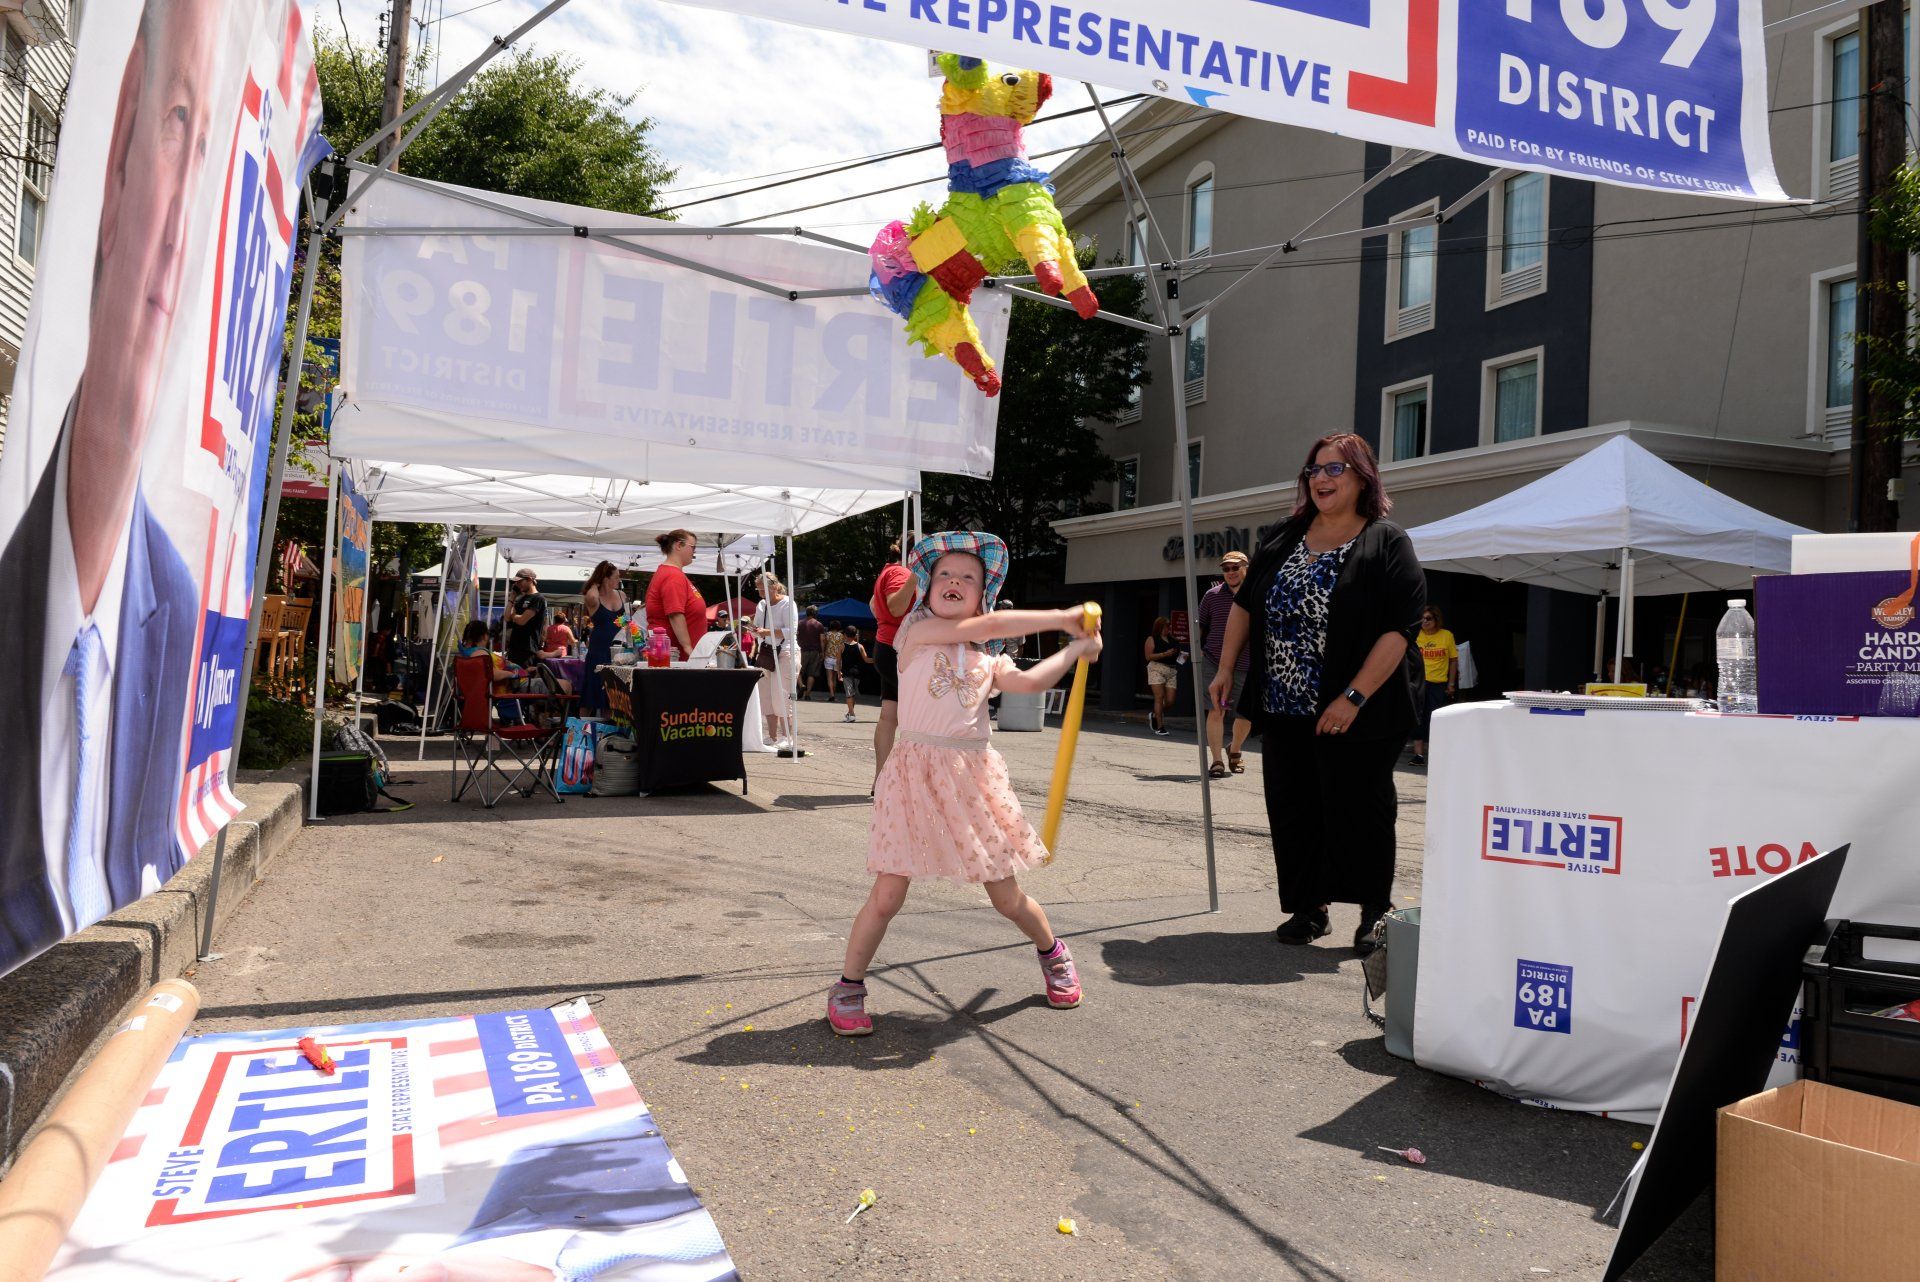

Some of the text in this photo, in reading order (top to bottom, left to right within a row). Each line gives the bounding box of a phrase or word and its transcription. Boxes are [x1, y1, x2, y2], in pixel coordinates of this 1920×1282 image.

[911, 0, 1331, 104] REPRESENTATIVE
[1506, 0, 1717, 68] 89
[1498, 52, 1715, 154] DISTRICT
[1467, 128, 1505, 149] PAID
[1510, 138, 1541, 157] FOR
[1545, 146, 1564, 162] BY
[1569, 151, 1631, 177] FRIENDS
[1635, 166, 1656, 180] OF
[1659, 171, 1701, 189] STEVE
[1865, 632, 1920, 645] HARD
[1856, 662, 1899, 672] PARTY
[660, 707, 734, 728] Sundance
[660, 722, 733, 742] Vacations
[1495, 805, 1587, 820] STATE REPRESENTATIVE
[1491, 817, 1611, 862] ERTLE
[1567, 862, 1600, 874] STEVE
[1709, 841, 1821, 878] VOTE
[1521, 969, 1567, 983] DISTRICT
[1518, 982, 1568, 1009] 189
[1527, 1007, 1557, 1028] PA
[505, 1014, 566, 1105] PA 189 DISTRICT
[391, 1049, 413, 1132] STATE REPRESENTATIVE
[204, 1048, 371, 1204] ERTLE
[151, 1147, 205, 1198] STEVE
